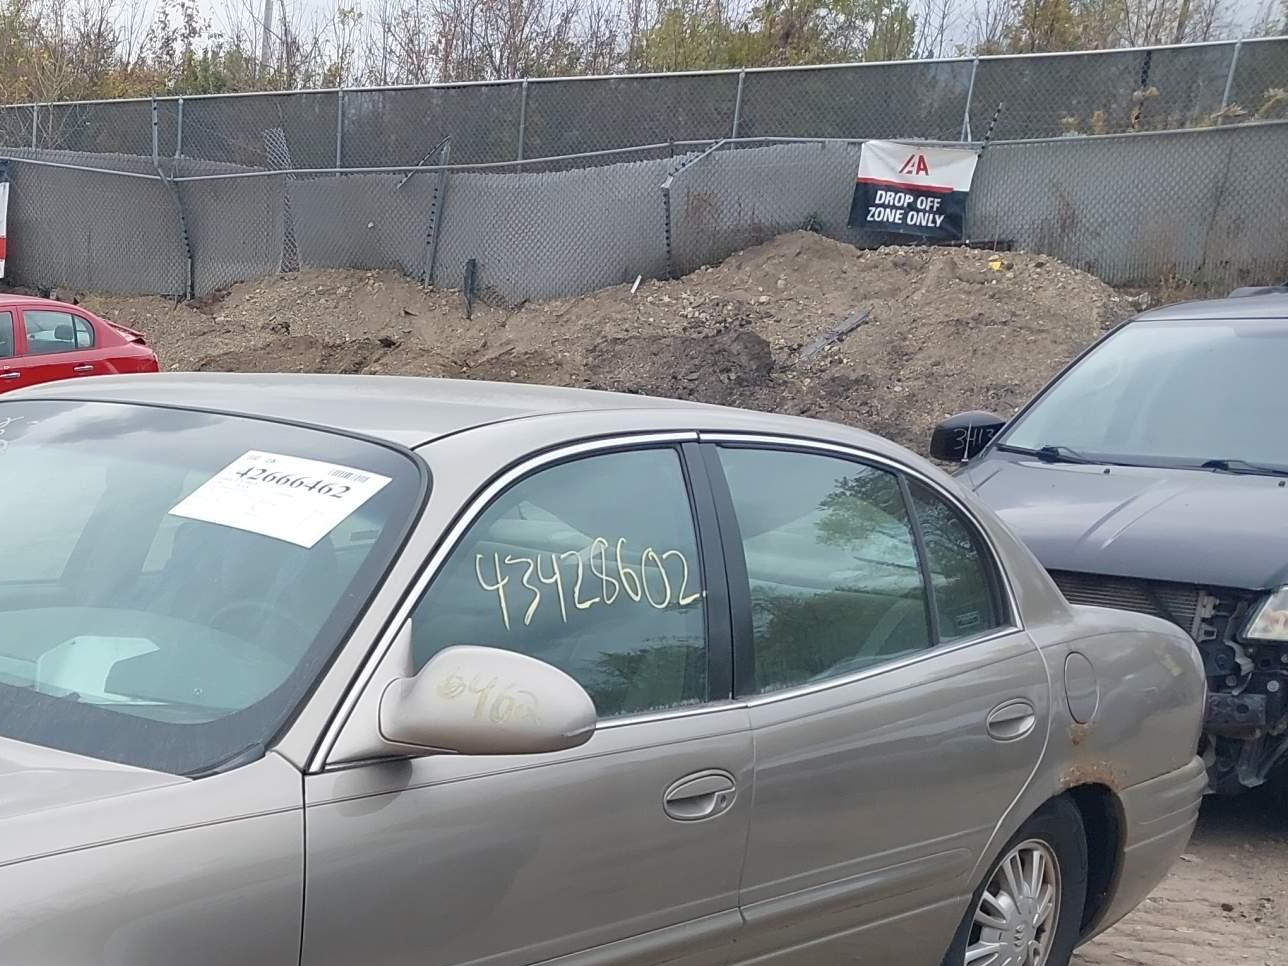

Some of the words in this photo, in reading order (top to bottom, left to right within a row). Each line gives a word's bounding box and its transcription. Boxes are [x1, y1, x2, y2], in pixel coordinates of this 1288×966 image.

[875, 190, 914, 208] DROP
[917, 196, 942, 211] OFF
[866, 207, 905, 224] ZONE
[907, 211, 944, 228] ONLY
[236, 466, 351, 499] 42666462
[475, 536, 701, 631] 43428602
